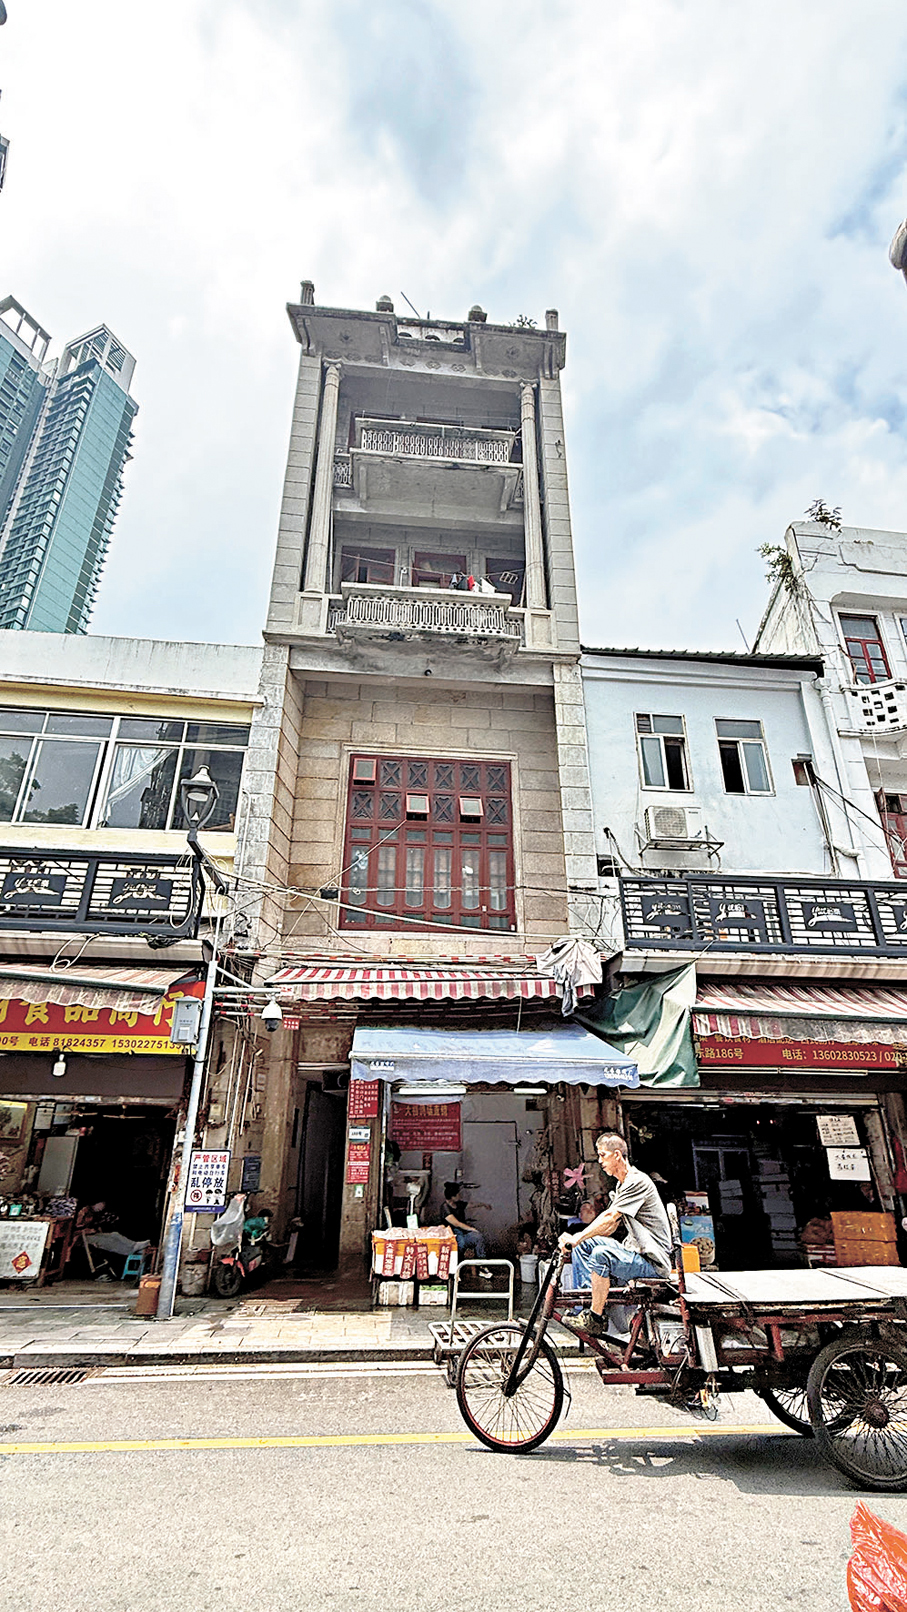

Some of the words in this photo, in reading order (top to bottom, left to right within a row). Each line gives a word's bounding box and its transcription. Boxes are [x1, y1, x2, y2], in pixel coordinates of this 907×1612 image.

[0, 1036, 19, 1046] 0号
[812, 1050, 877, 1062] 13602830523
[193, 1154, 227, 1163] 严管区域
[190, 1176, 225, 1189] 乱停放
